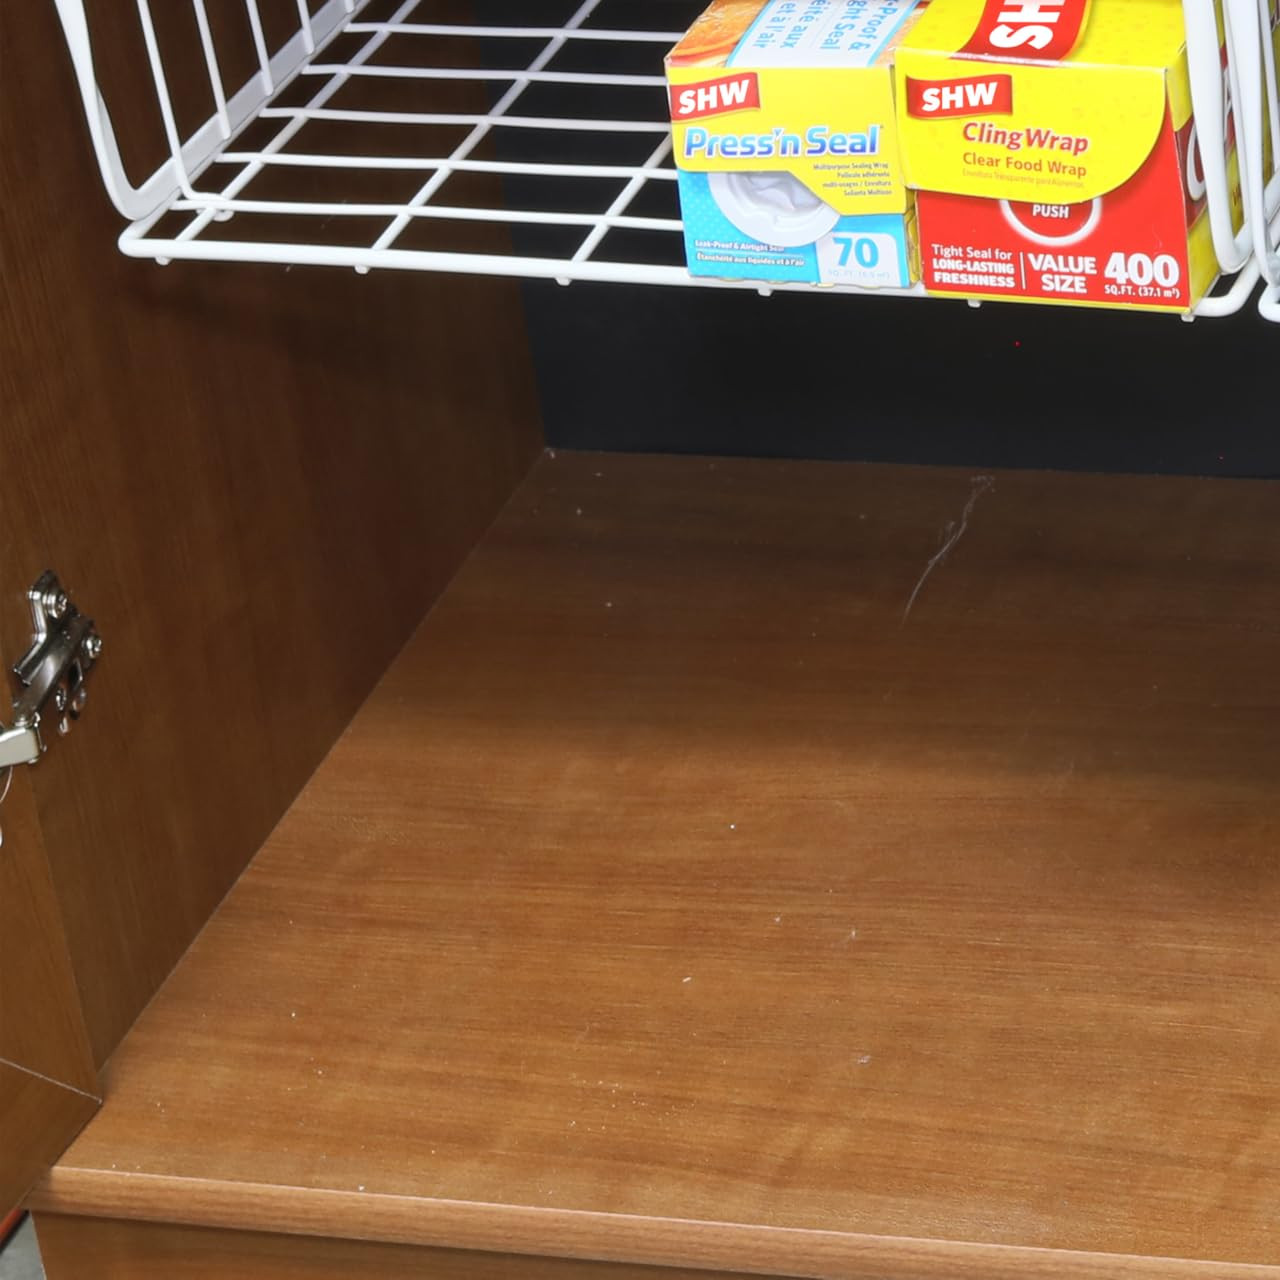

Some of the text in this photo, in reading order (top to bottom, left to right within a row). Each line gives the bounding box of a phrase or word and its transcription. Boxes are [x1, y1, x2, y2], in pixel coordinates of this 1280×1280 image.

[779, 25, 808, 49] aux
[820, 23, 856, 50] Seal
[678, 80, 749, 115] SHW
[922, 82, 998, 112] SHW
[684, 126, 880, 157] Press'n Seal
[963, 152, 1087, 179] Clear Food Wrap
[1032, 204, 1069, 219] PUSH
[832, 236, 879, 269] 70
[932, 243, 1013, 261] Tight Seal for
[1027, 253, 1097, 274] VALUE
[932, 258, 1015, 274] LONG-LASTING
[1103, 252, 1180, 288] 400
[933, 271, 1016, 288] FRESHNESS
[1041, 275, 1088, 293] SIZE
[1138, 285, 1162, 298] (37.1
